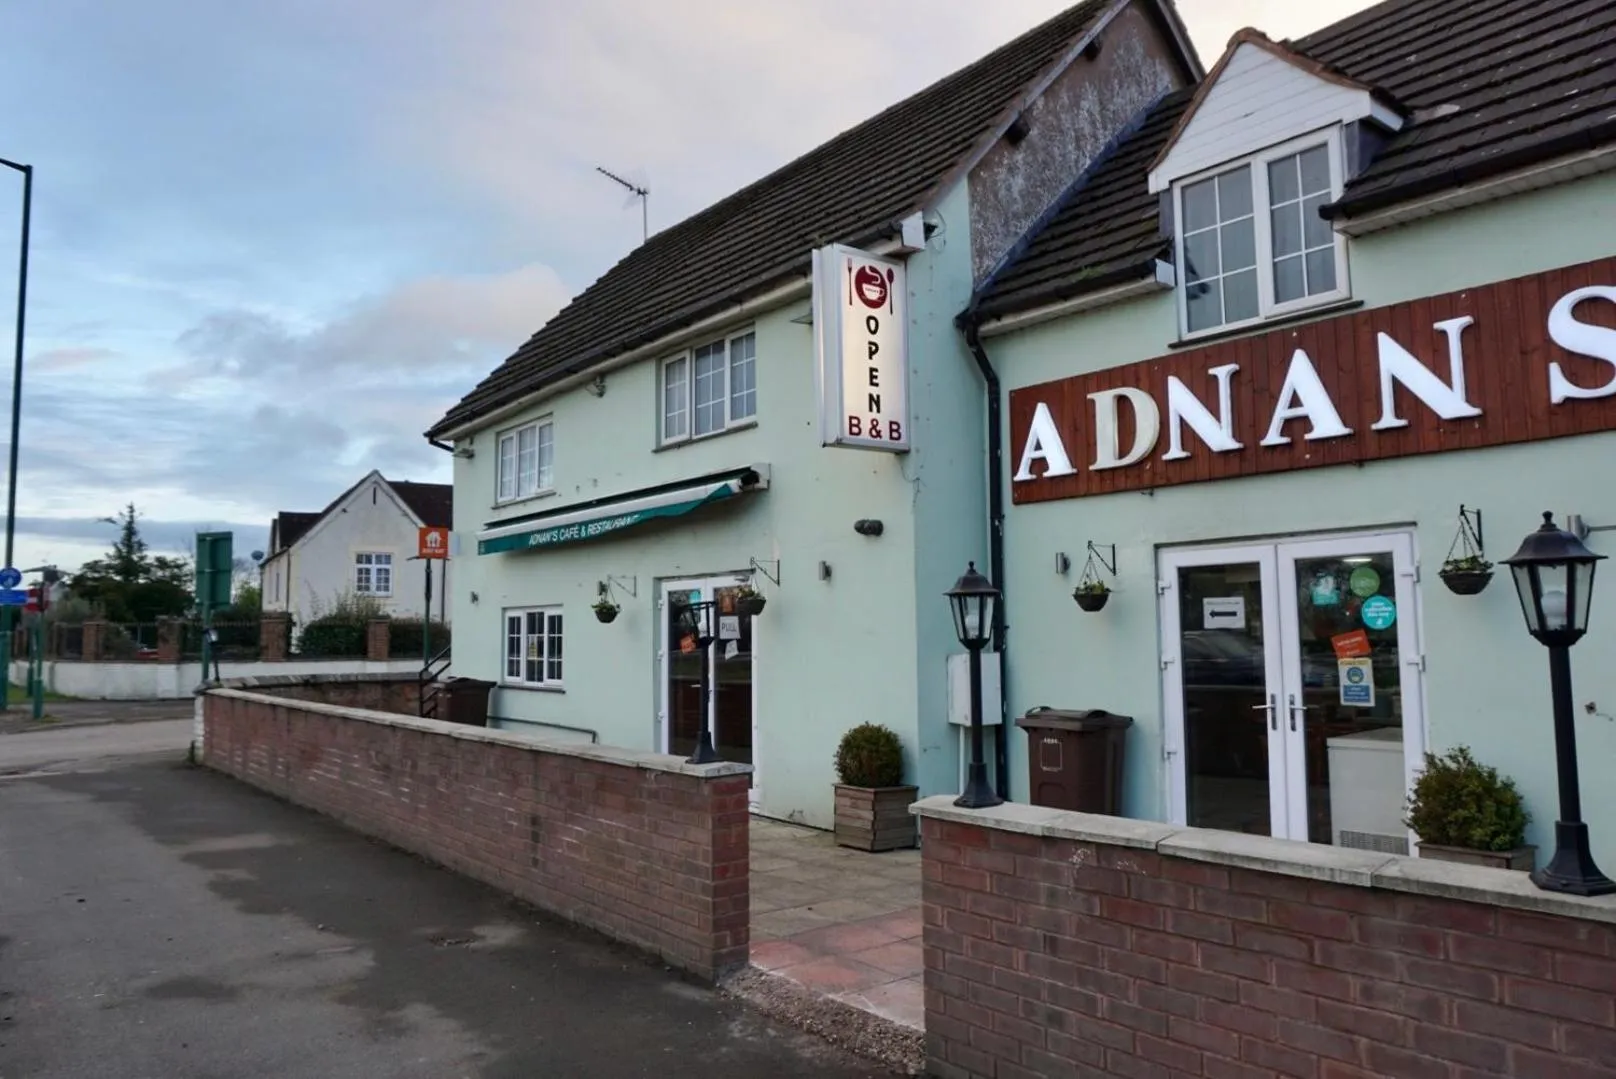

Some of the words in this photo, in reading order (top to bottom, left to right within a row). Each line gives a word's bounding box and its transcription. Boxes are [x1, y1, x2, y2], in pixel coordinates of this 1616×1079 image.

[866, 315, 881, 414] OPEN
[848, 415, 862, 436] B
[869, 418, 882, 439] &
[889, 420, 902, 441] B
[1013, 315, 1482, 481] ADNAN
[529, 530, 558, 547] ADNAN'S
[581, 525, 586, 537] &
